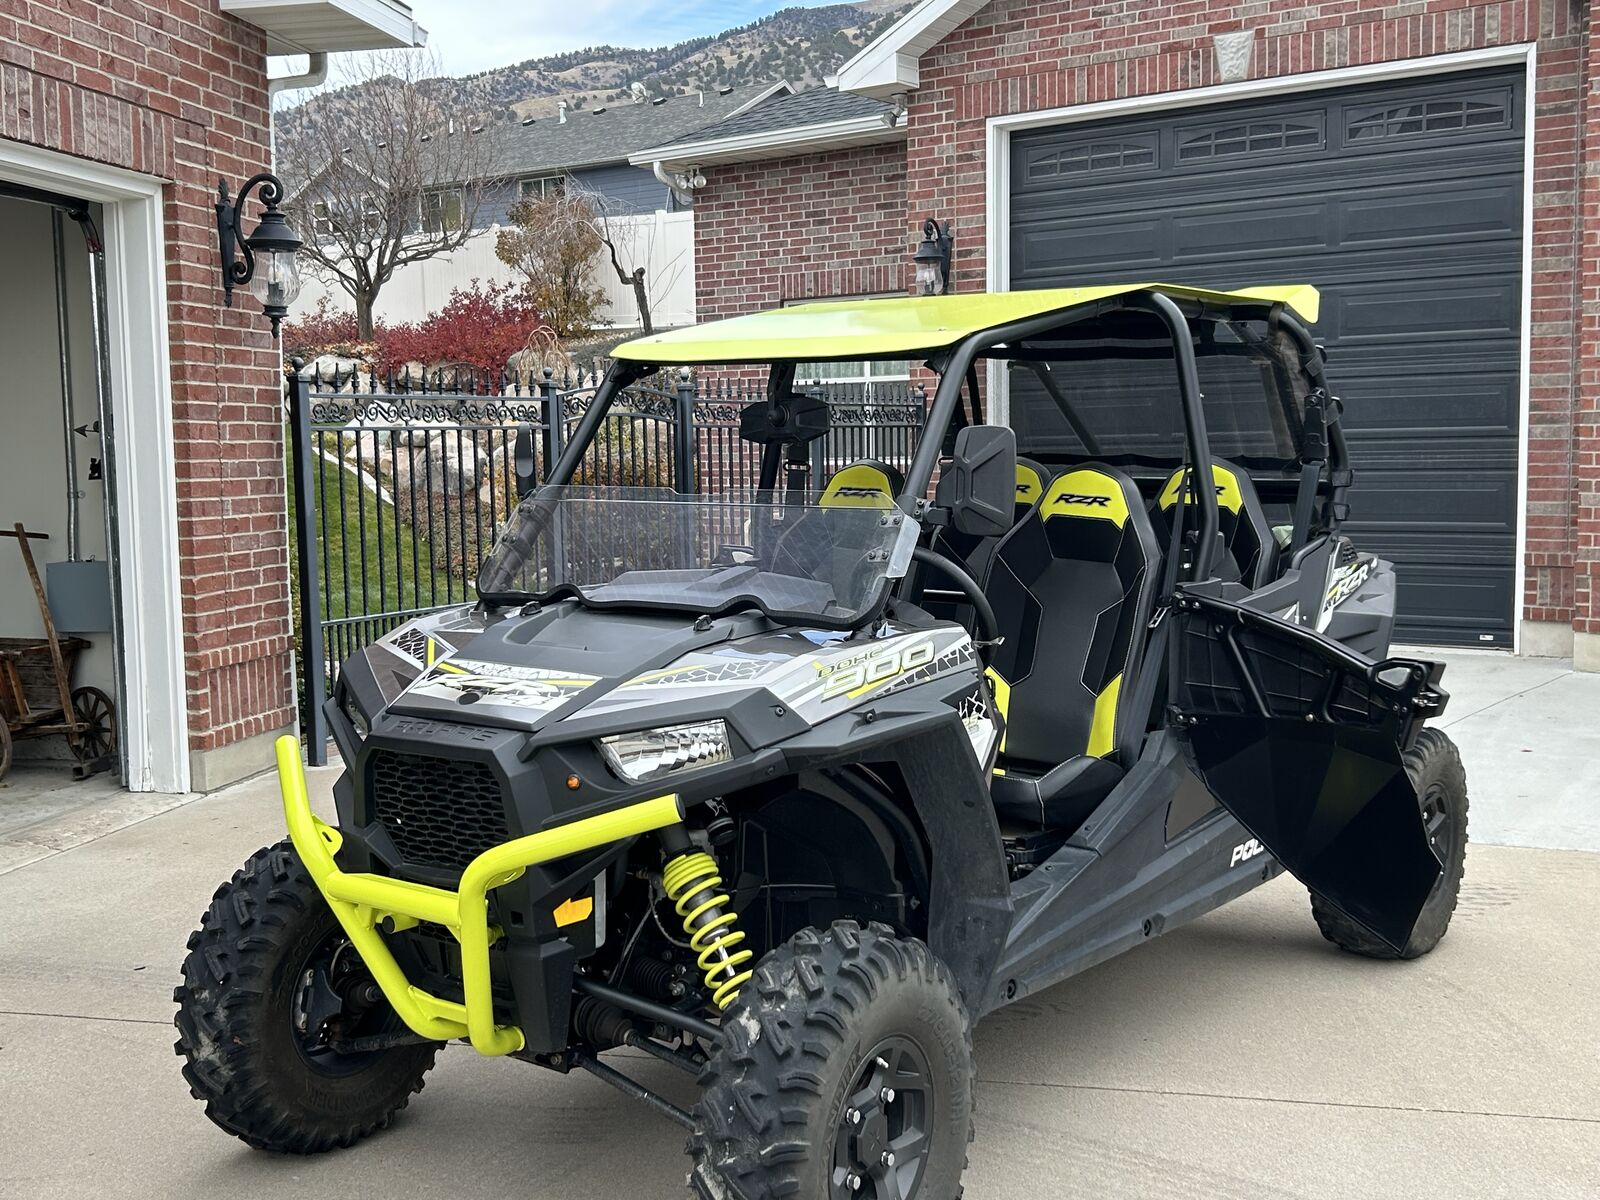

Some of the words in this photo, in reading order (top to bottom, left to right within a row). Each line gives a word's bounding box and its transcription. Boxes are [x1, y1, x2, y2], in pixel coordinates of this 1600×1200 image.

[1053, 493, 1112, 508] RZR
[816, 646, 884, 679] DOHC
[820, 640, 936, 703] 900
[387, 719, 499, 742] POLARIS
[1229, 838, 1265, 868] POL
